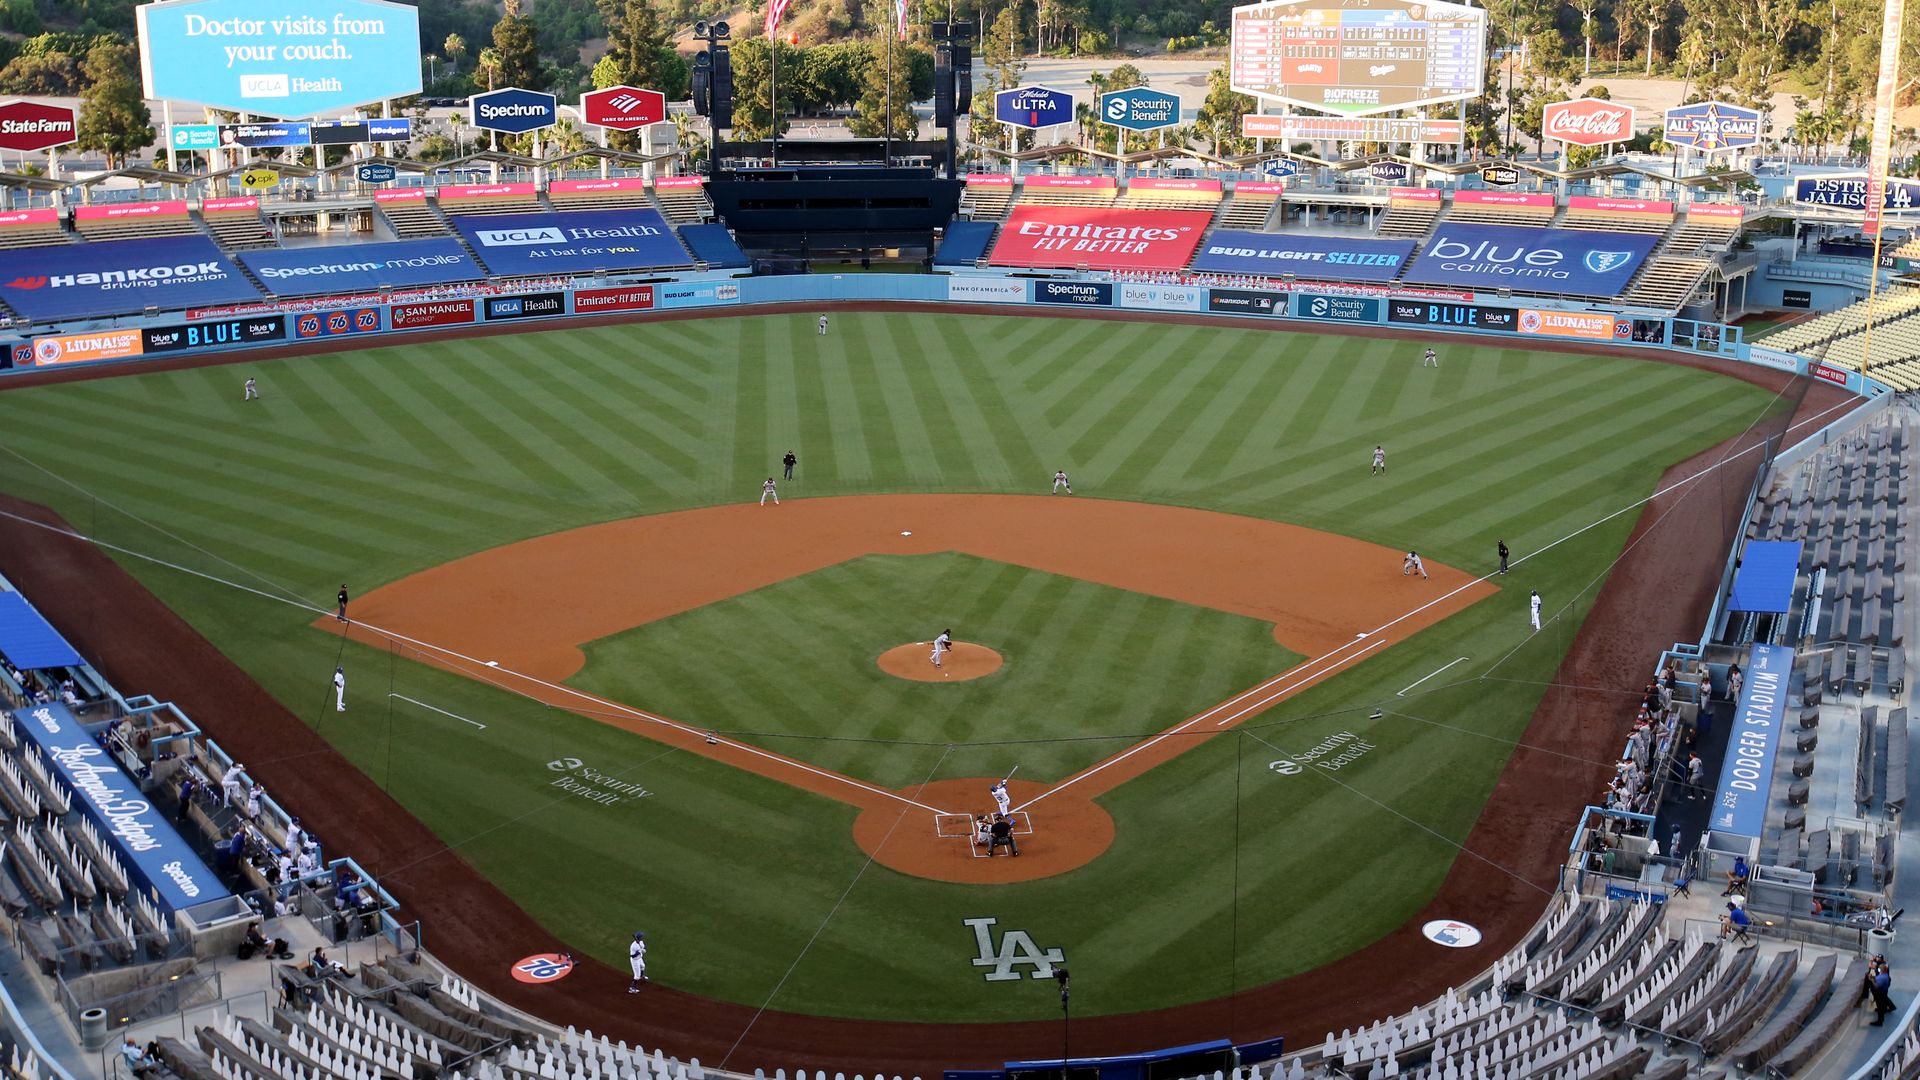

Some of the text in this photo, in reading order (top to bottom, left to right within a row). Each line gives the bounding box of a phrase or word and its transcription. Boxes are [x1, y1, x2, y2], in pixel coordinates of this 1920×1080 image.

[185, 13, 385, 36] Doctor visits from
[224, 39, 352, 69] your couch.
[247, 77, 342, 93] UCLA Health
[1324, 88, 1380, 99] BIOFREEZE
[480, 104, 545, 120] Spectrum
[1012, 99, 1057, 111] ULTRA
[1131, 98, 1173, 112] Security
[1131, 110, 1167, 121] Benefit
[1550, 109, 1628, 135] Coca-Cola
[190, 130, 217, 139] Security
[370, 126, 408, 136] @Dodgers
[1720, 121, 1755, 134] GAME
[257, 174, 274, 184] cpk
[372, 168, 393, 176] Security
[1372, 166, 1405, 177] DASANI
[1496, 170, 1517, 179] MGM
[1866, 161, 1883, 222] Emirates
[490, 225, 661, 243] UCLA Health
[1019, 221, 1178, 241] Emirates
[529, 245, 640, 258] At bat for you.
[1032, 237, 1150, 254] FLY BETTER
[1428, 237, 1564, 266] blue
[1208, 246, 1400, 267] BUD LIGHT SELTZER
[259, 263, 377, 279] Spectrum
[1440, 262, 1570, 280] california
[101, 272, 228, 291] driving emotion
[1047, 283, 1097, 296] Spectrum
[1125, 290, 1185, 301] blue blue
[495, 299, 558, 313] UCLA Health
[577, 292, 651, 307] Emirates FLY BETTER
[1072, 294, 1096, 303] mobile
[1331, 299, 1366, 311] Security
[406, 303, 471, 316] SAN MANUEL
[1331, 309, 1361, 319] Benefit
[1397, 306, 1414, 315] blue
[1429, 305, 1478, 325] BLUE
[1485, 312, 1502, 321] blue
[302, 319, 318, 333] 76
[329, 316, 347, 330] 76
[358, 314, 375, 327] 76
[406, 315, 433, 323] CASINO
[1591, 318, 1611, 326] LOCAL
[151, 333, 170, 343] blue
[188, 323, 242, 346] BLUE
[249, 324, 268, 333] blue
[1616, 325, 1629, 334] 76
[16, 347, 33, 361] 76
[1745, 672, 1780, 728] STADIUM
[32, 707, 62, 734] Spectrum
[1290, 730, 1360, 763] Security
[1316, 741, 1377, 771] Benefit
[1731, 732, 1768, 792] DODGER
[574, 767, 655, 799] Security
[50, 743, 163, 852] Los Angeles Dodgers
[550, 776, 621, 806] Benefit
[161, 860, 200, 898] Spectrum
[963, 917, 1066, 982] LA
[516, 957, 570, 979] 76
